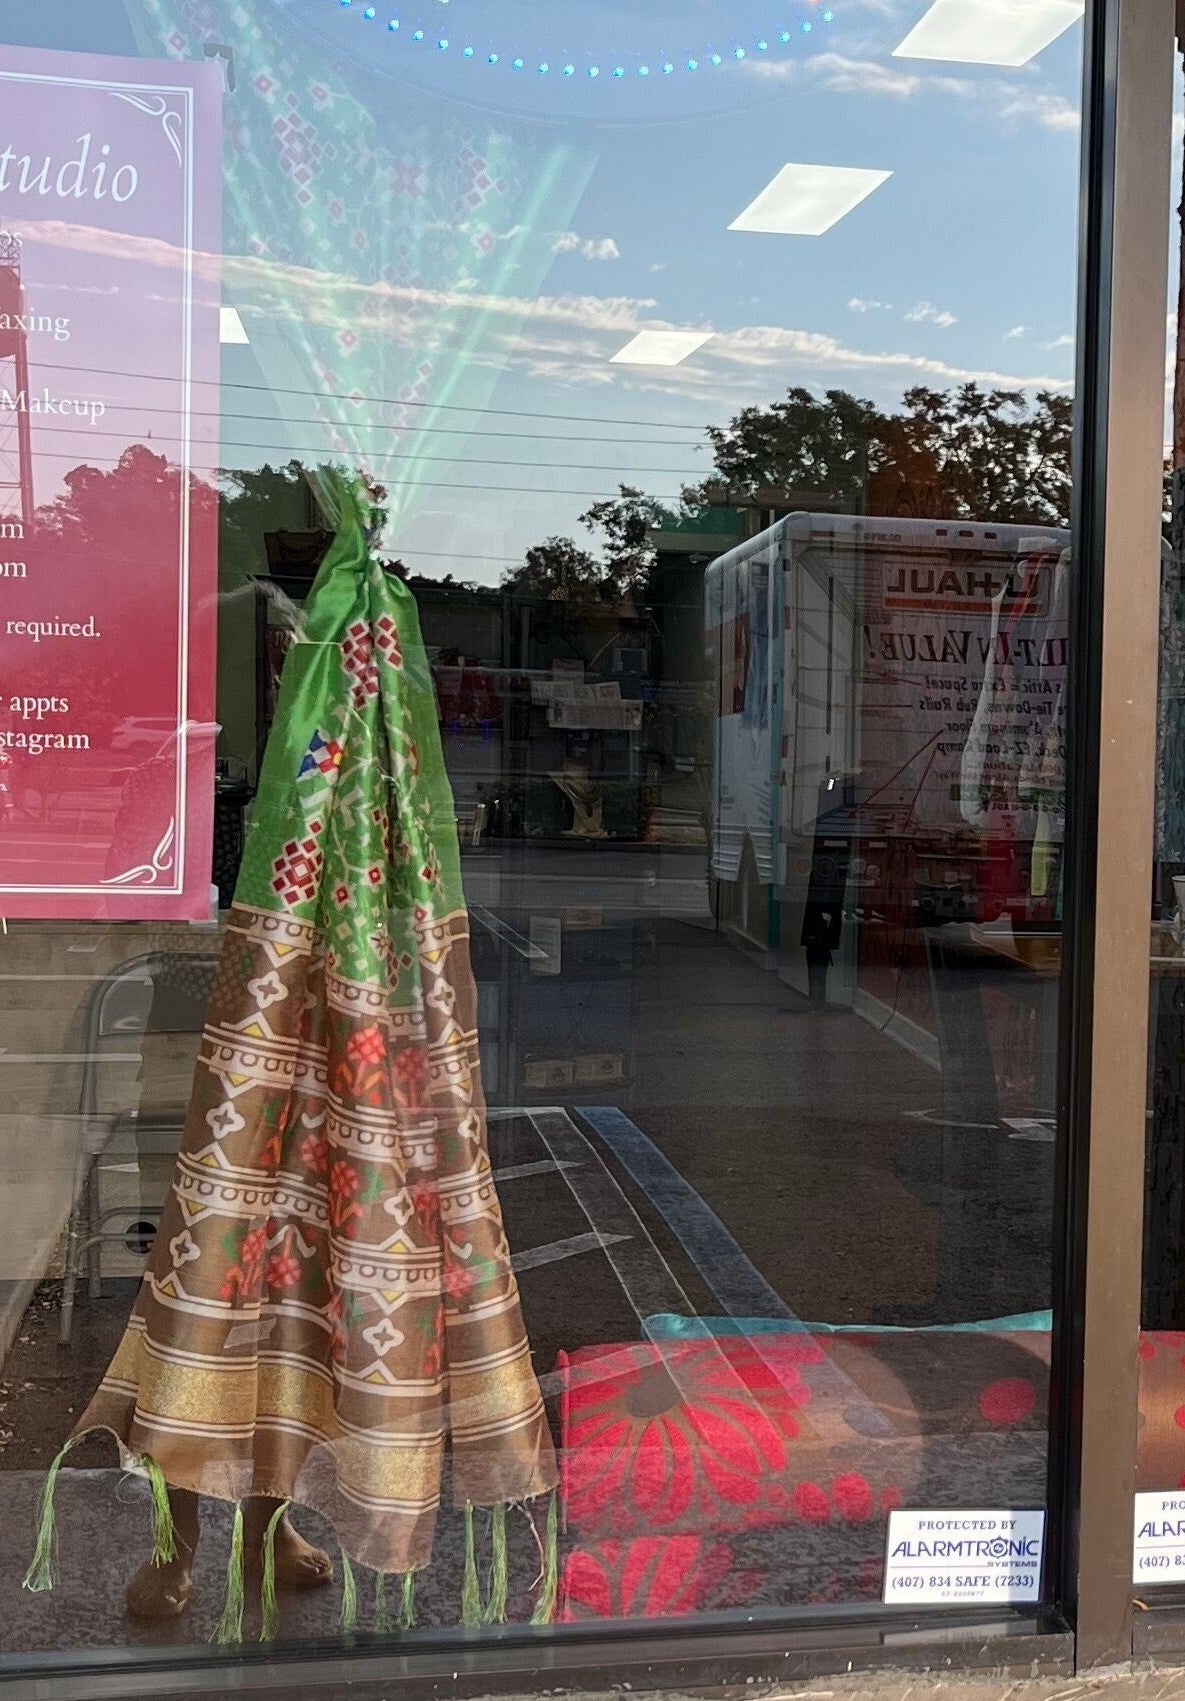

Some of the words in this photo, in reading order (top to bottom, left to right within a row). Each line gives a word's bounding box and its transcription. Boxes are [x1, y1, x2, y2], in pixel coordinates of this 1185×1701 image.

[1, 388, 106, 426] Makeup
[6, 615, 101, 643] required.
[10, 695, 70, 720] appts
[918, 1519, 996, 1531] PROTECTED
[1000, 1519, 1018, 1531] BY
[891, 1535, 1040, 1559] ALARMTRONIC
[986, 1560, 1038, 1568] SYSTEMS
[1138, 1556, 1171, 1569] (407)
[891, 1576, 925, 1589] (407)
[929, 1576, 952, 1588] 834
[955, 1575, 991, 1587] SAFE
[995, 1574, 1035, 1589] (7233)
